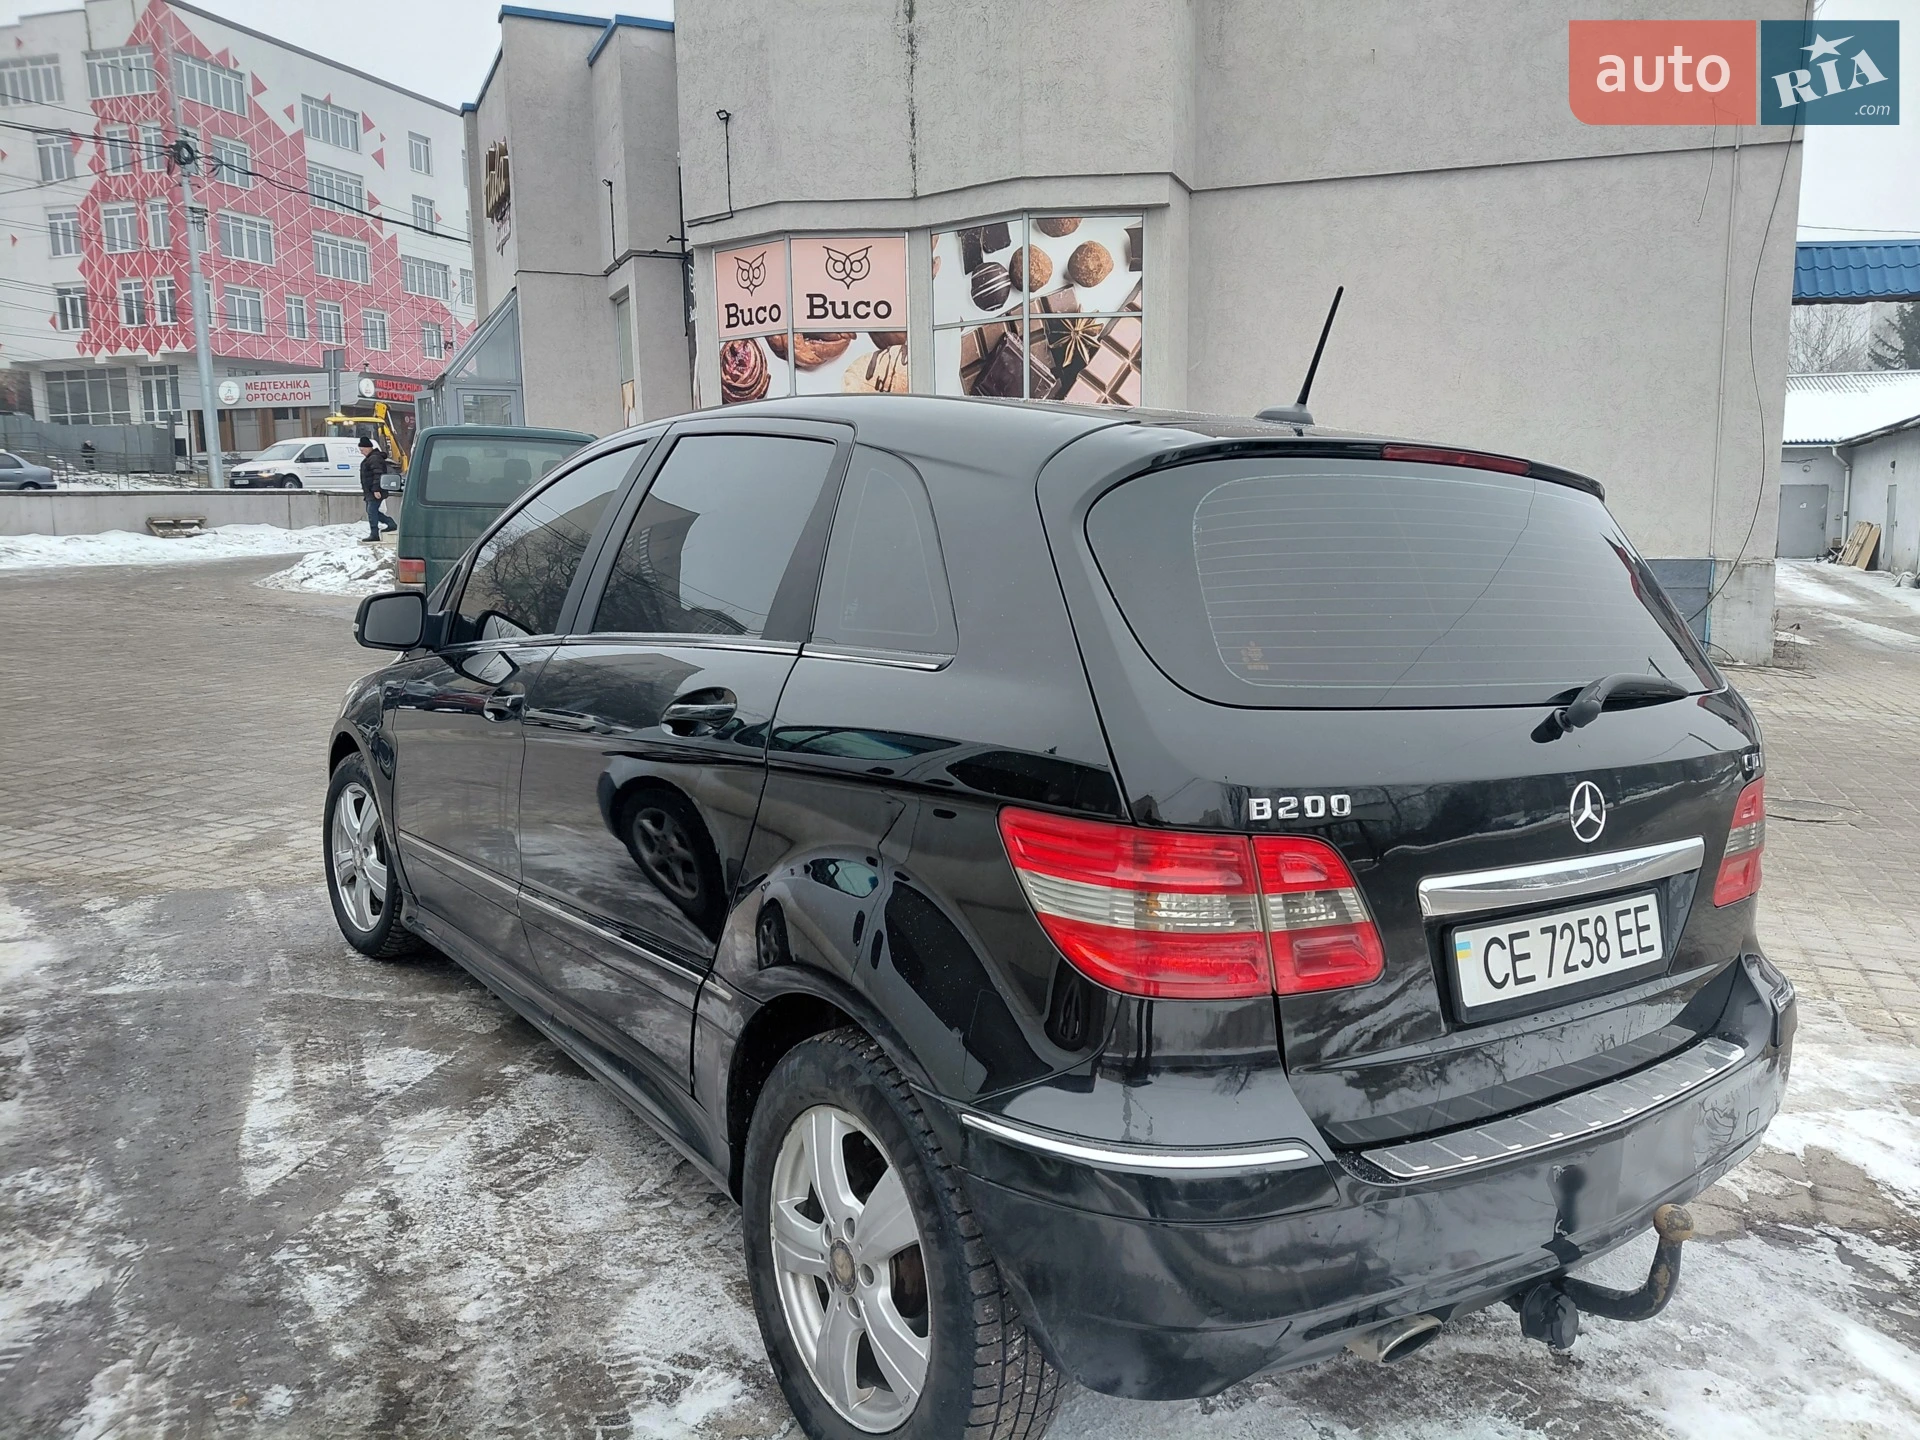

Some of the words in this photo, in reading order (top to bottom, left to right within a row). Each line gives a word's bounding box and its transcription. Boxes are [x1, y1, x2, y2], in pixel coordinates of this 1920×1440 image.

[724, 302, 782, 329] Buco
[806, 293, 893, 321] Buco
[245, 379, 311, 391] МЕДТЕХНІКА
[246, 391, 311, 403] ОРТОСАЛОН
[1248, 794, 1353, 822] B200
[1483, 930, 1537, 990] CE
[1540, 914, 1611, 980] 7258
[1616, 903, 1656, 959] EE
